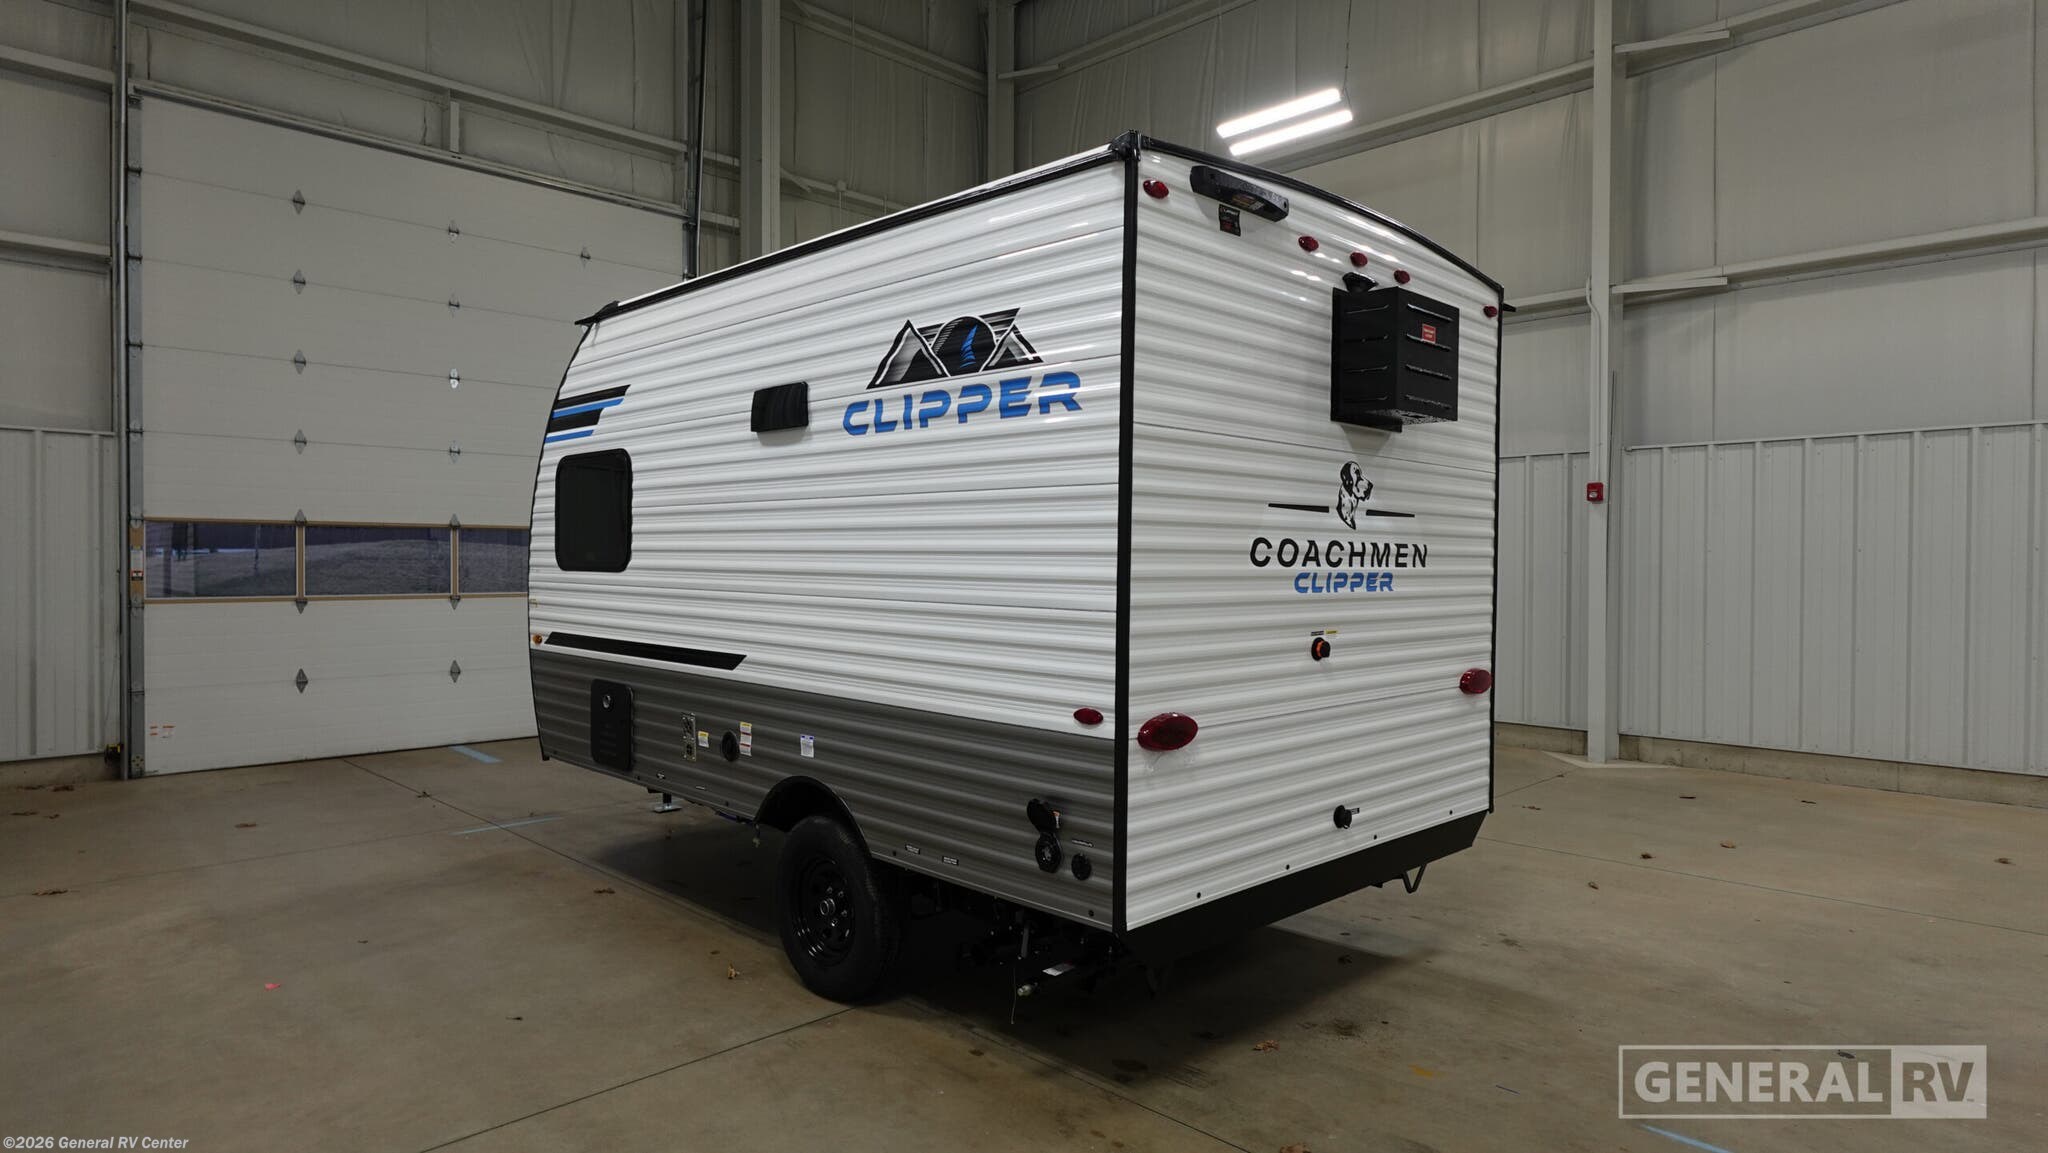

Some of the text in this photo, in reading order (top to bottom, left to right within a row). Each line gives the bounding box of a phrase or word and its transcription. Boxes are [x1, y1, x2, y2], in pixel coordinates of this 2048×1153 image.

[843, 371, 1082, 436] CLIPPER
[1250, 537, 1428, 568] COACHMEN
[1294, 572, 1394, 593] CLIPPER
